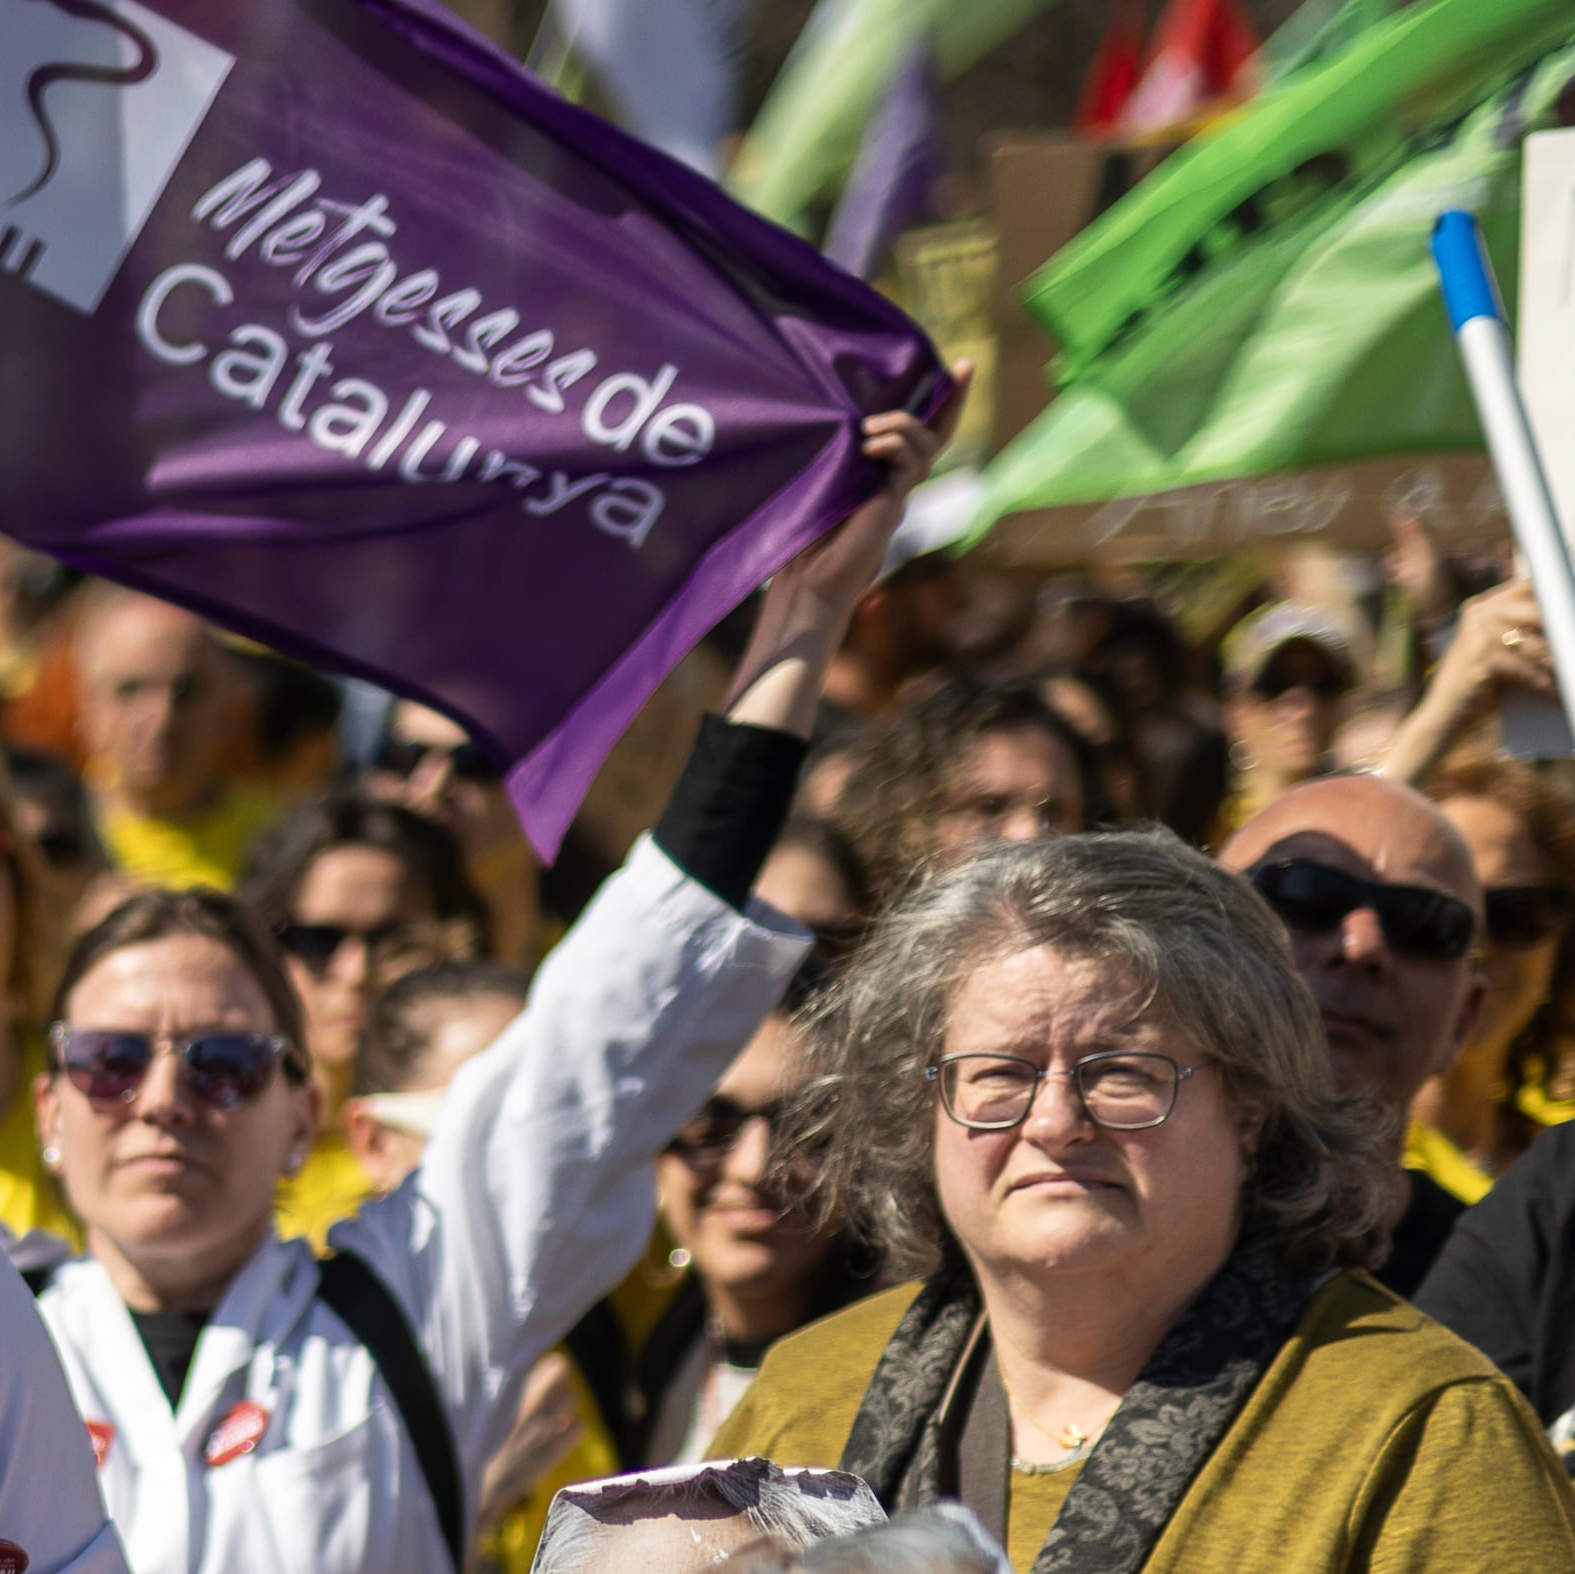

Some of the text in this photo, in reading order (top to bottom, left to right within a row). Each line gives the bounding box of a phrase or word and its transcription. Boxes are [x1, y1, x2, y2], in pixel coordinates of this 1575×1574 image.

[136, 264, 666, 548] Catalunya
[192, 157, 716, 465] Metgesses de
